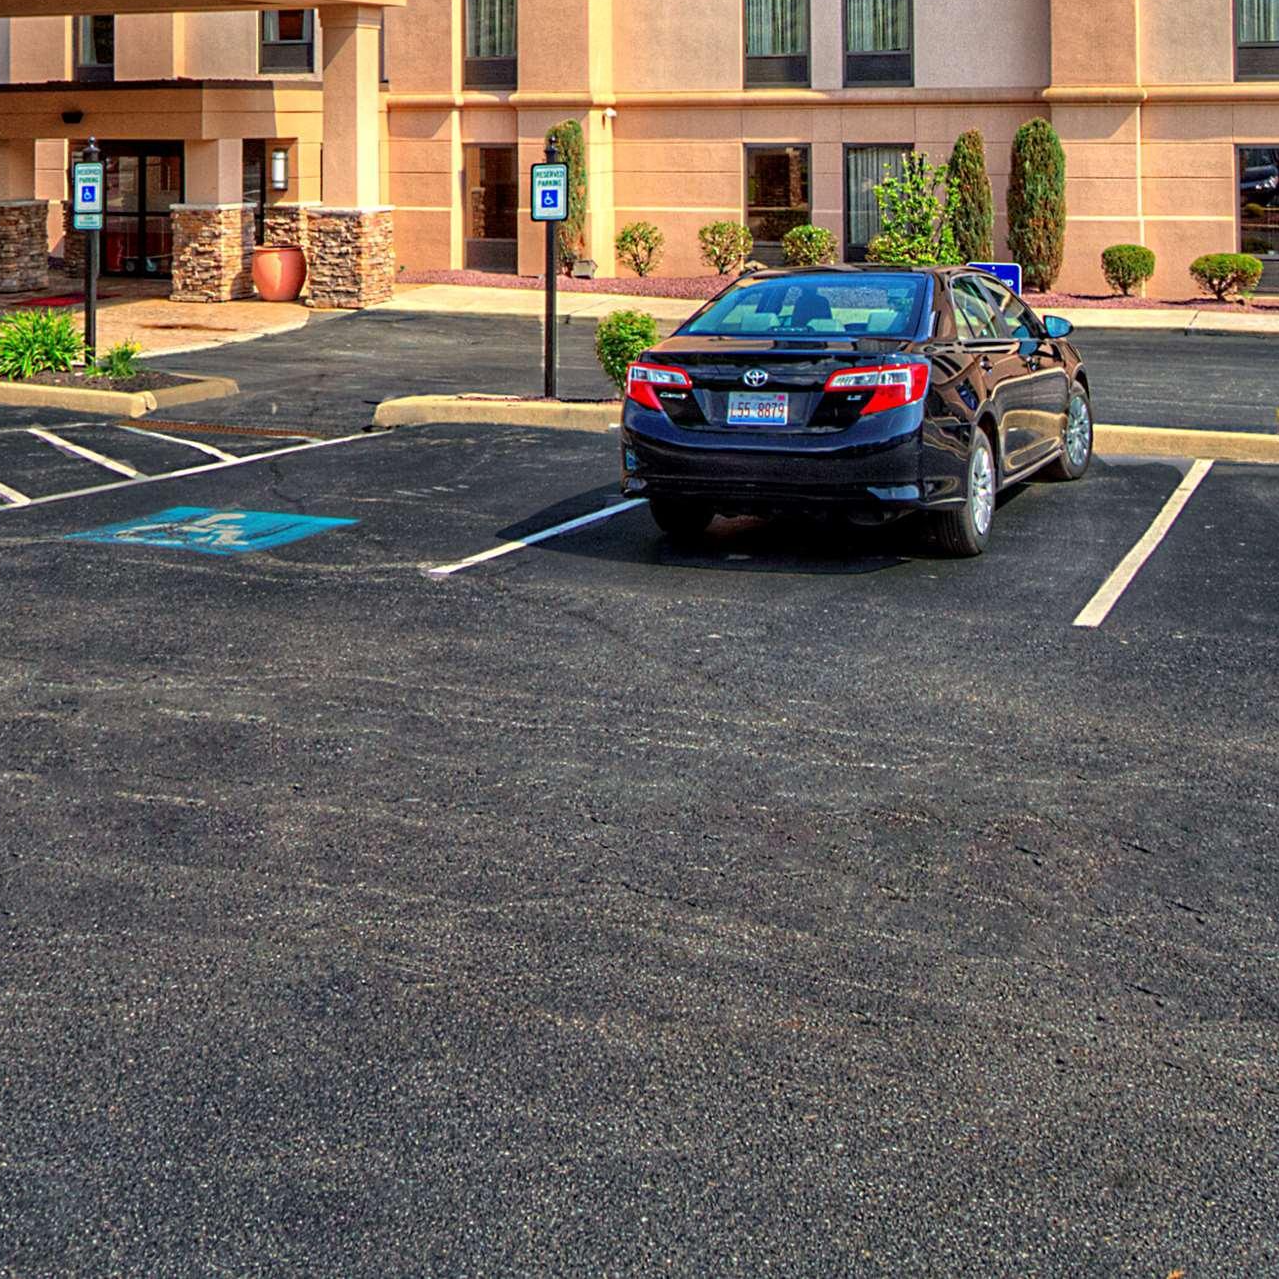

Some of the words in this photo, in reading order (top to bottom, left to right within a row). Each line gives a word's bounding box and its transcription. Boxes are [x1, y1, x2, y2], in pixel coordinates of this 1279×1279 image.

[536, 169, 565, 178] RESERVED
[537, 179, 562, 187] PARKING
[757, 402, 785, 419] 8879
